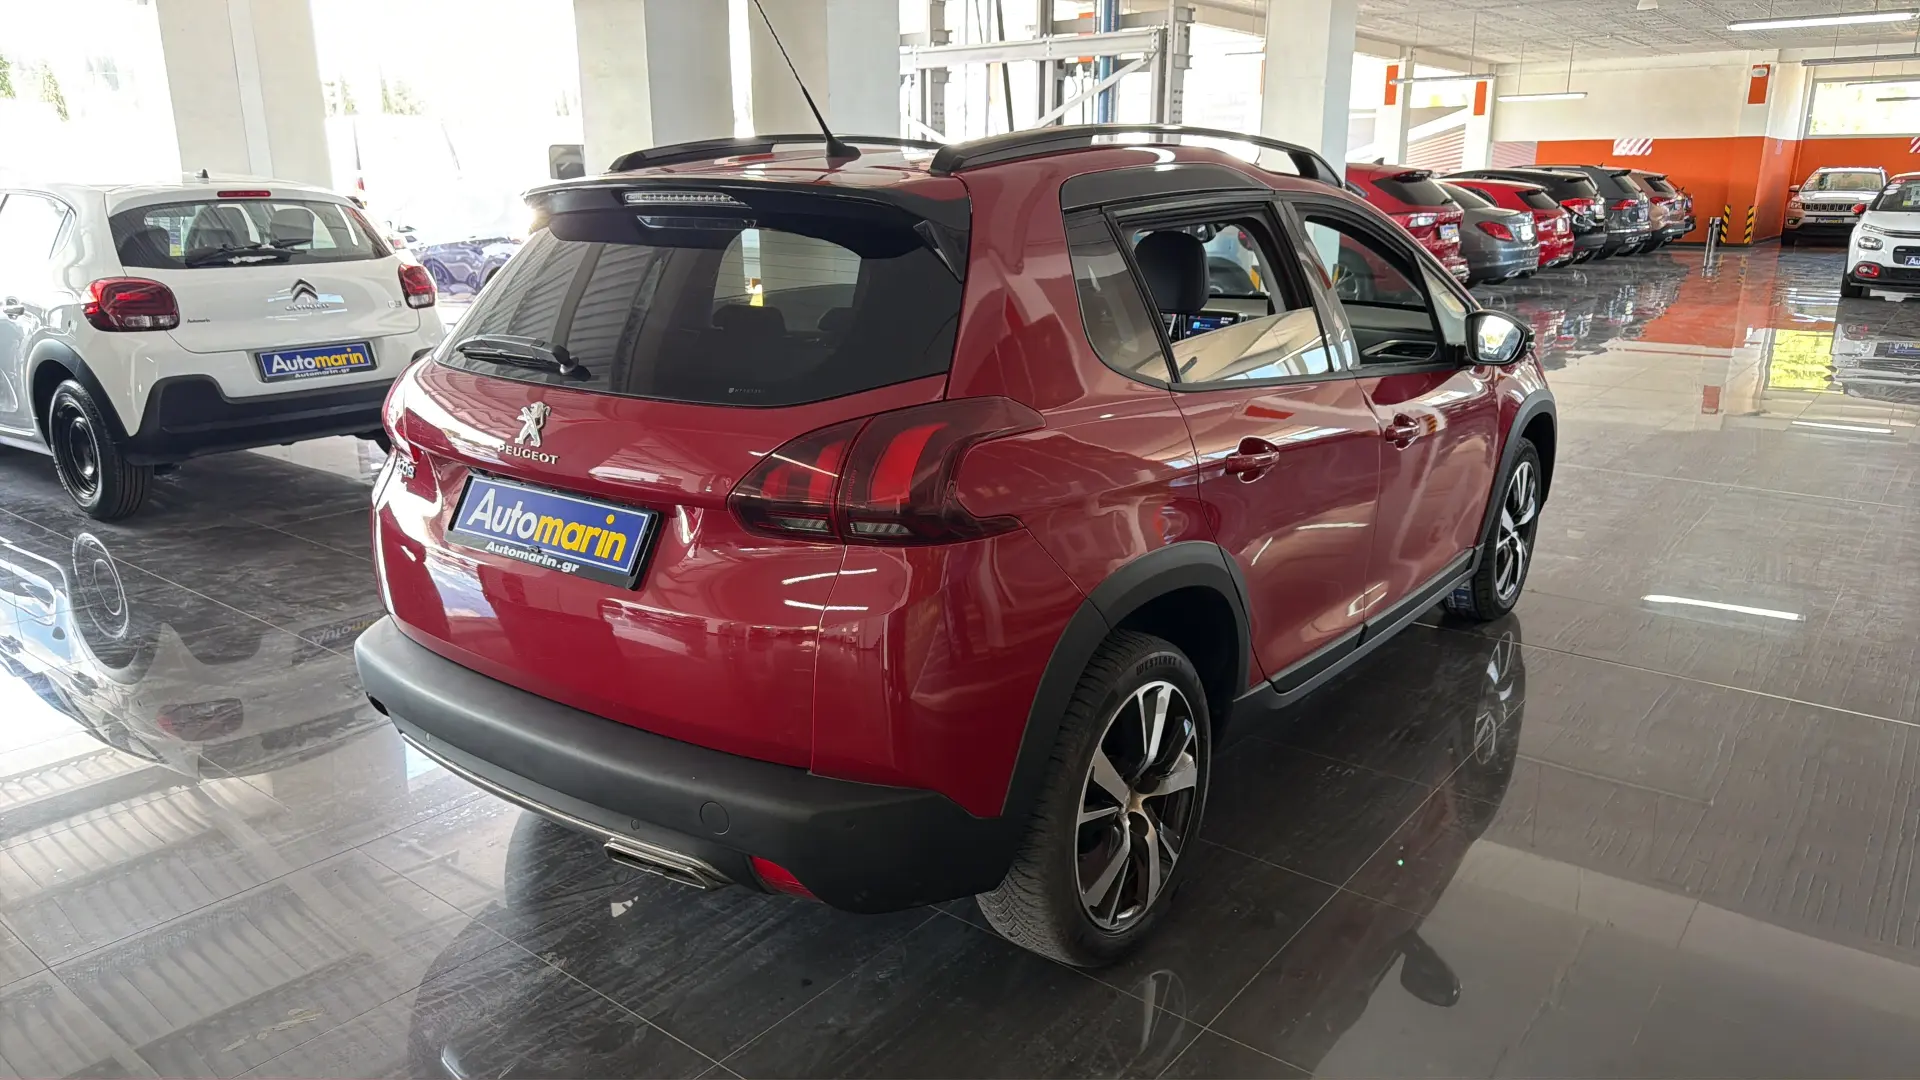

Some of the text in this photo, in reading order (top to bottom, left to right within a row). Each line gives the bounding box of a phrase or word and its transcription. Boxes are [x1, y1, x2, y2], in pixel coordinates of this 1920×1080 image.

[272, 347, 365, 373] Automarin
[294, 367, 350, 379] Automarin.gr
[497, 443, 559, 465] PEUGEOT
[466, 487, 627, 562] Automarin
[484, 541, 580, 574] Automarin.gr
[1136, 655, 1177, 676] WESTLAKE
